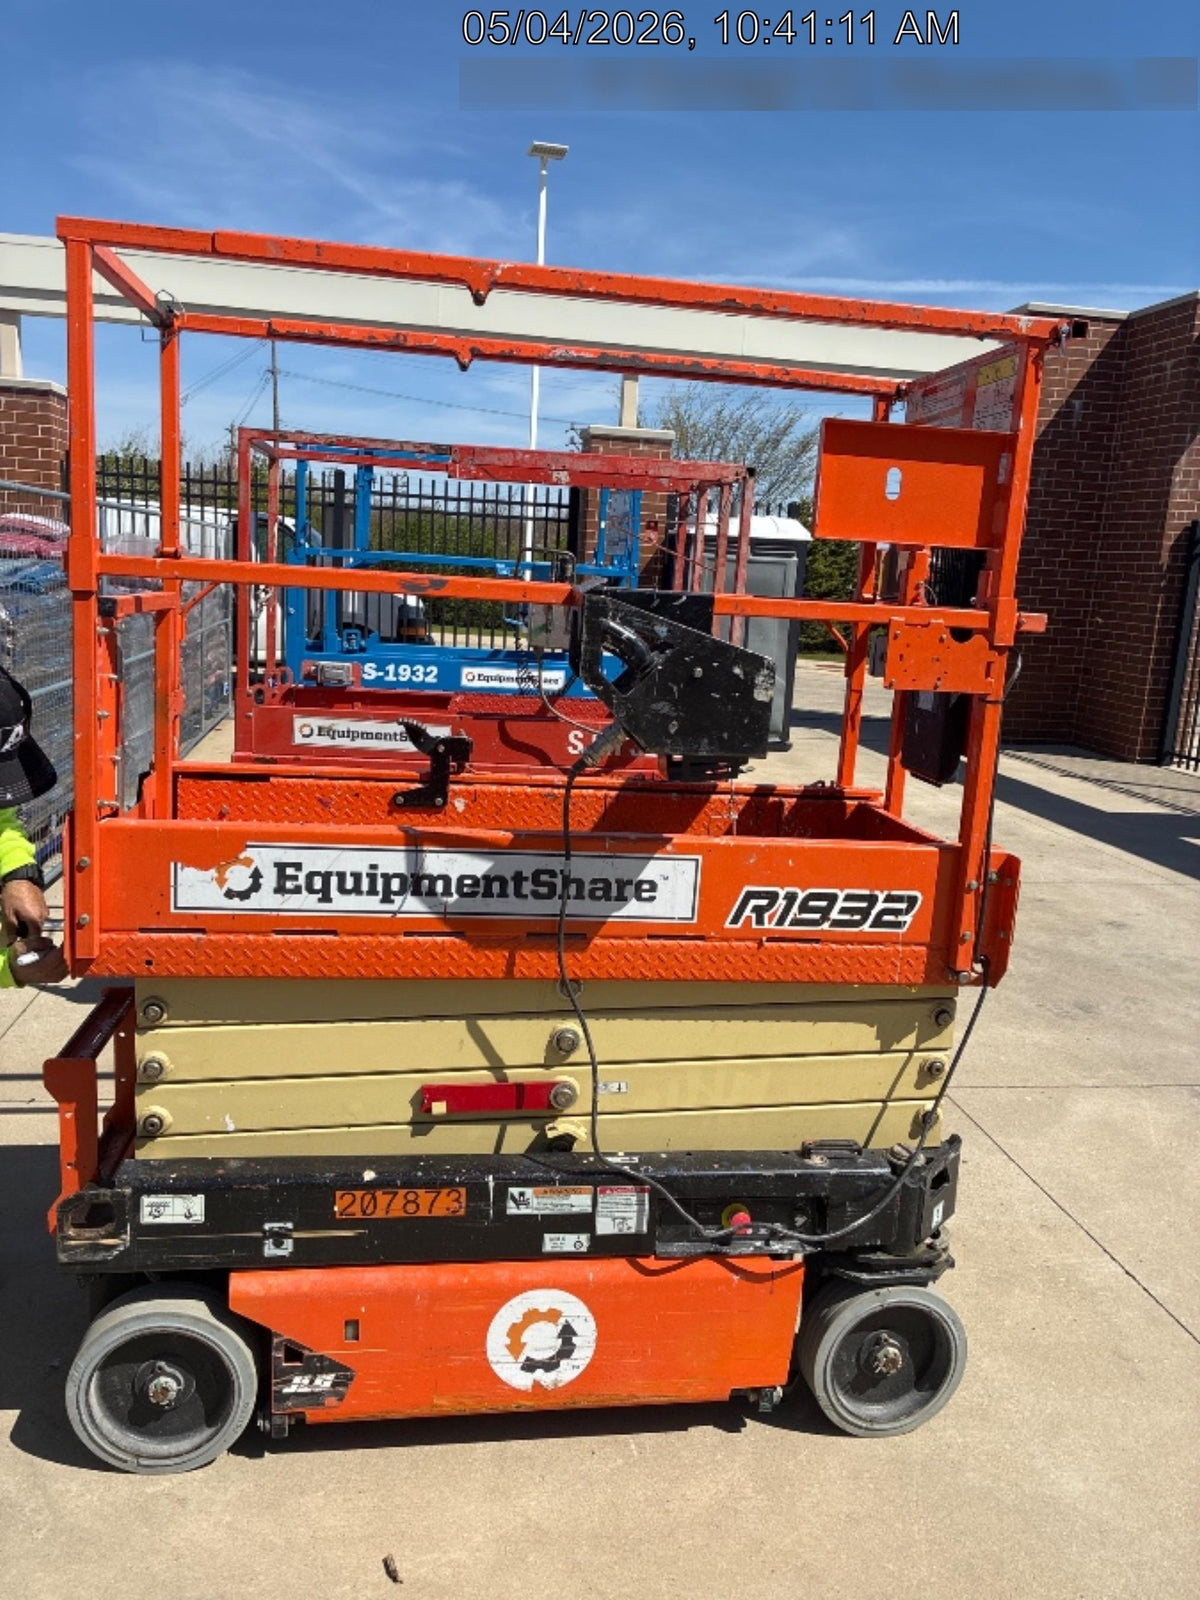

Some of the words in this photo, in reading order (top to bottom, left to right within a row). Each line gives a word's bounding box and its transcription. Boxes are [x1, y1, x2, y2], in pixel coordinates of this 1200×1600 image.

[362, 662, 438, 683] S-1932
[316, 724, 411, 742] EquipmentS
[273, 861, 658, 904] EquipmentShare
[725, 886, 921, 932] R1932
[338, 1188, 464, 1217] 207873
